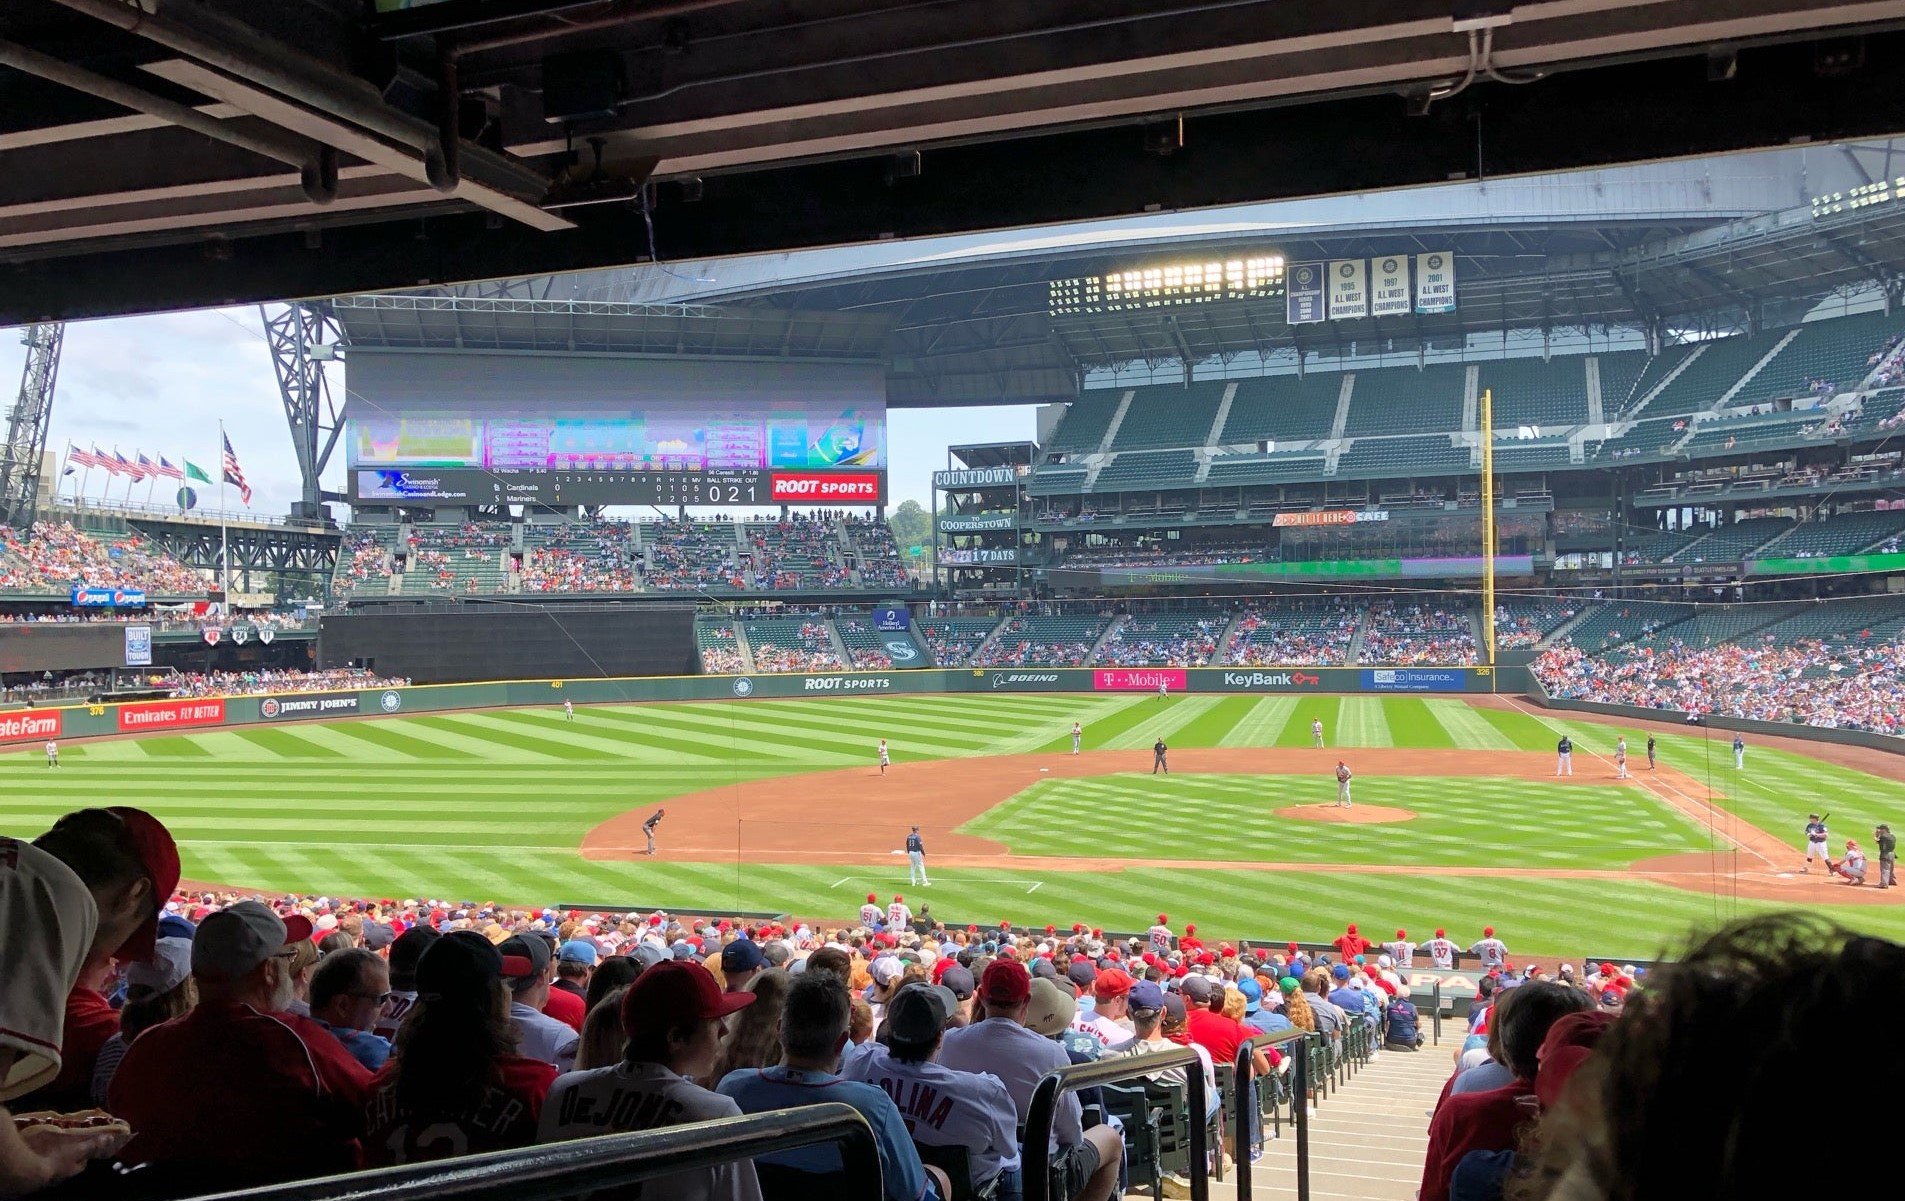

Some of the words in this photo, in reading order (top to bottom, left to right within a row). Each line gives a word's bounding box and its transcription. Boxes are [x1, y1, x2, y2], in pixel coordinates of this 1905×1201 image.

[1384, 278, 1398, 287] 1997
[1428, 274, 1442, 282] 2001
[1341, 282, 1355, 292] 1995
[1433, 285, 1448, 294] WEST
[1346, 292, 1361, 302] WEST
[1389, 289, 1404, 298] WEST
[1375, 300, 1408, 312] CHAMPIONS
[1420, 296, 1452, 306] CHAMPIONS
[1332, 304, 1364, 315] CHAMPIONS
[396, 473, 438, 486] Swinomish
[935, 469, 1014, 485] COUNTDOWN
[776, 480, 819, 493] ROOT
[821, 483, 874, 493] SPORTS
[710, 486, 720, 502] 0
[728, 486, 739, 502] 2
[748, 486, 754, 502] 1
[1356, 512, 1388, 520] CAFE
[940, 518, 1011, 530] COOPERSTOWN
[991, 550, 1014, 560] DAYS
[128, 631, 148, 640] BUILT
[264, 632, 270, 640] 11
[129, 652, 149, 660] TOUGH
[1224, 672, 1291, 687] KeyBank
[1376, 672, 1405, 681] Safeco
[1408, 672, 1450, 681] Insurance
[805, 678, 843, 690] ROOT
[844, 679, 890, 689] SPORTS
[90, 706, 104, 716] 376
[281, 700, 318, 713] JIMMY
[320, 699, 357, 710] JOHN'S
[125, 710, 176, 724] Emirates
[180, 707, 192, 719] FLY
[194, 705, 220, 718] BETTER
[890, 912, 900, 921] 75
[1154, 934, 1166, 945] 50
[1435, 948, 1447, 958] 37
[1489, 949, 1496, 959] 8
[866, 1078, 954, 1130] OLINA
